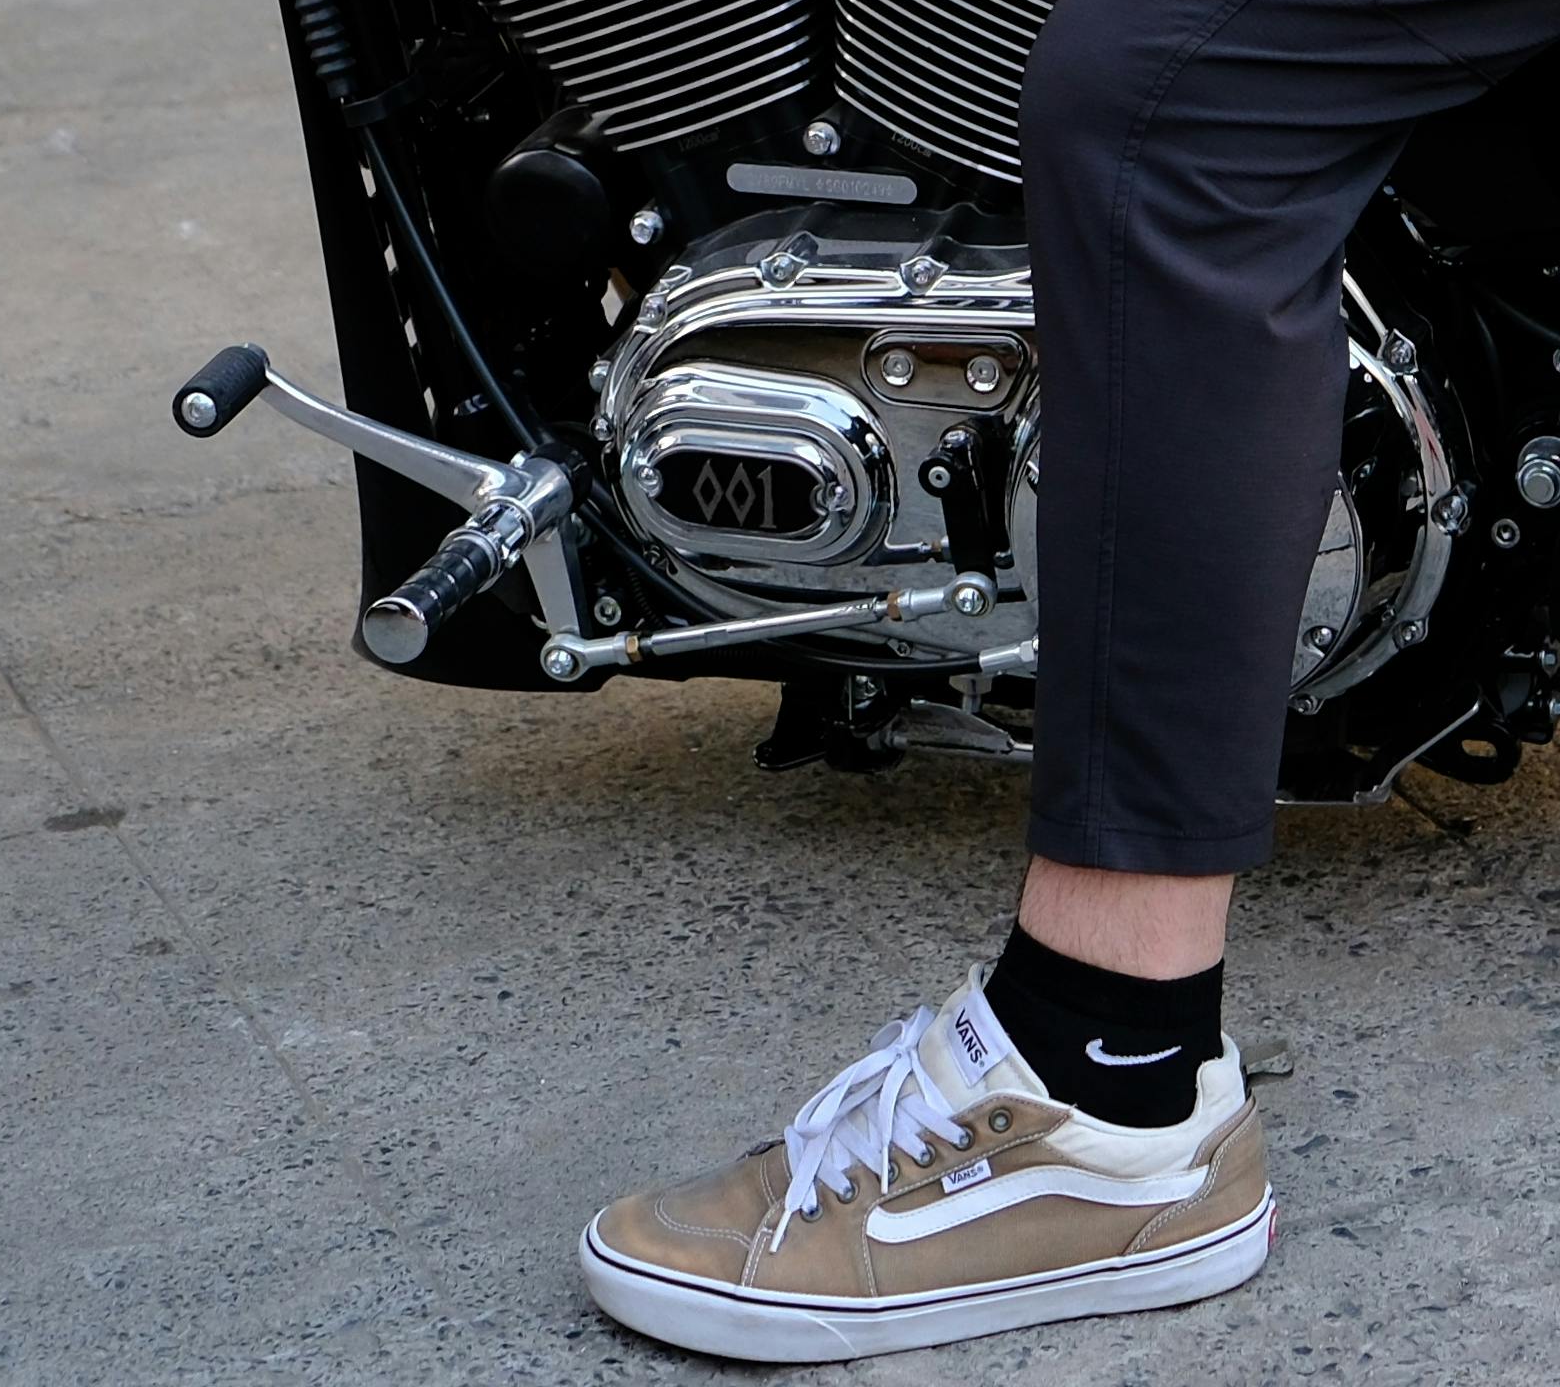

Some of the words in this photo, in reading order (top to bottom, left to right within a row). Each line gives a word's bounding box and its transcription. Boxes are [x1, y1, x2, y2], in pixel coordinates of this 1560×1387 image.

[692, 458, 777, 529] 001
[955, 1007, 988, 1064] VANS
[947, 1167, 978, 1185] VANS
